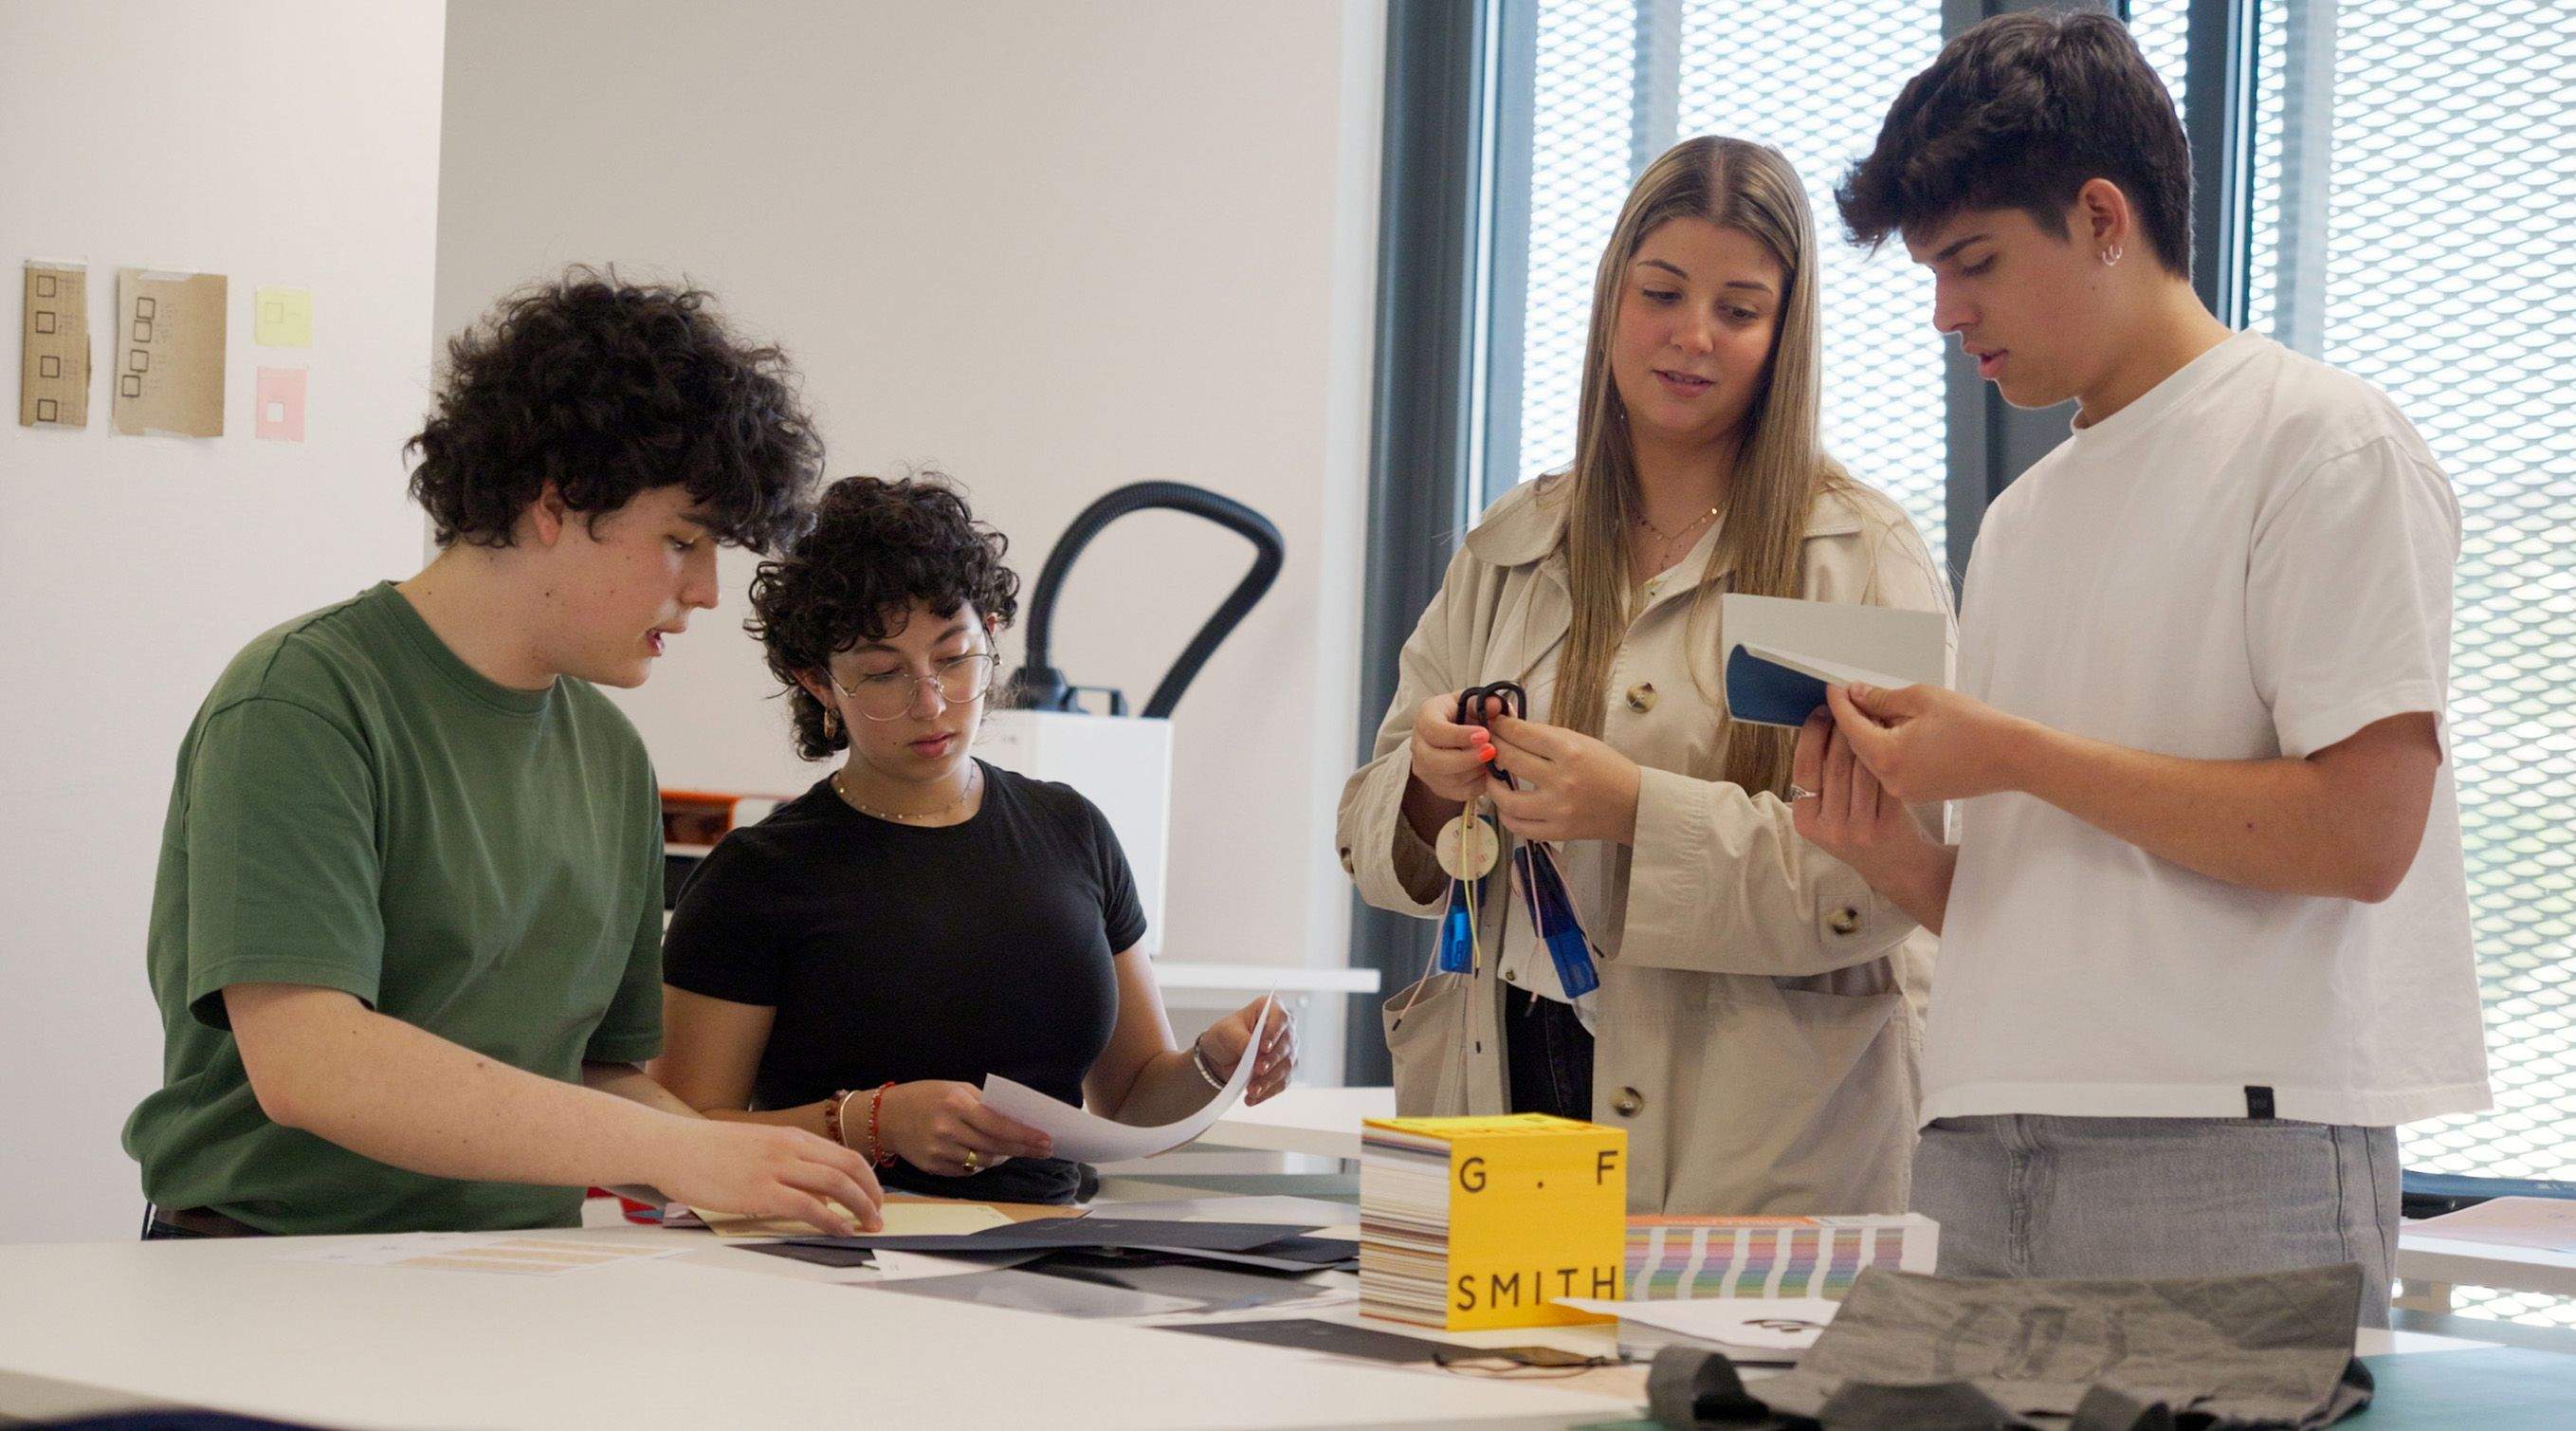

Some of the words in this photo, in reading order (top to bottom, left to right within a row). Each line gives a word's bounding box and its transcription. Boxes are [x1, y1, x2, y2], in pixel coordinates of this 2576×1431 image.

[1459, 1156, 1487, 1193] G
[1597, 1149, 1618, 1185] F
[1456, 1265, 1616, 1311] SMITH
